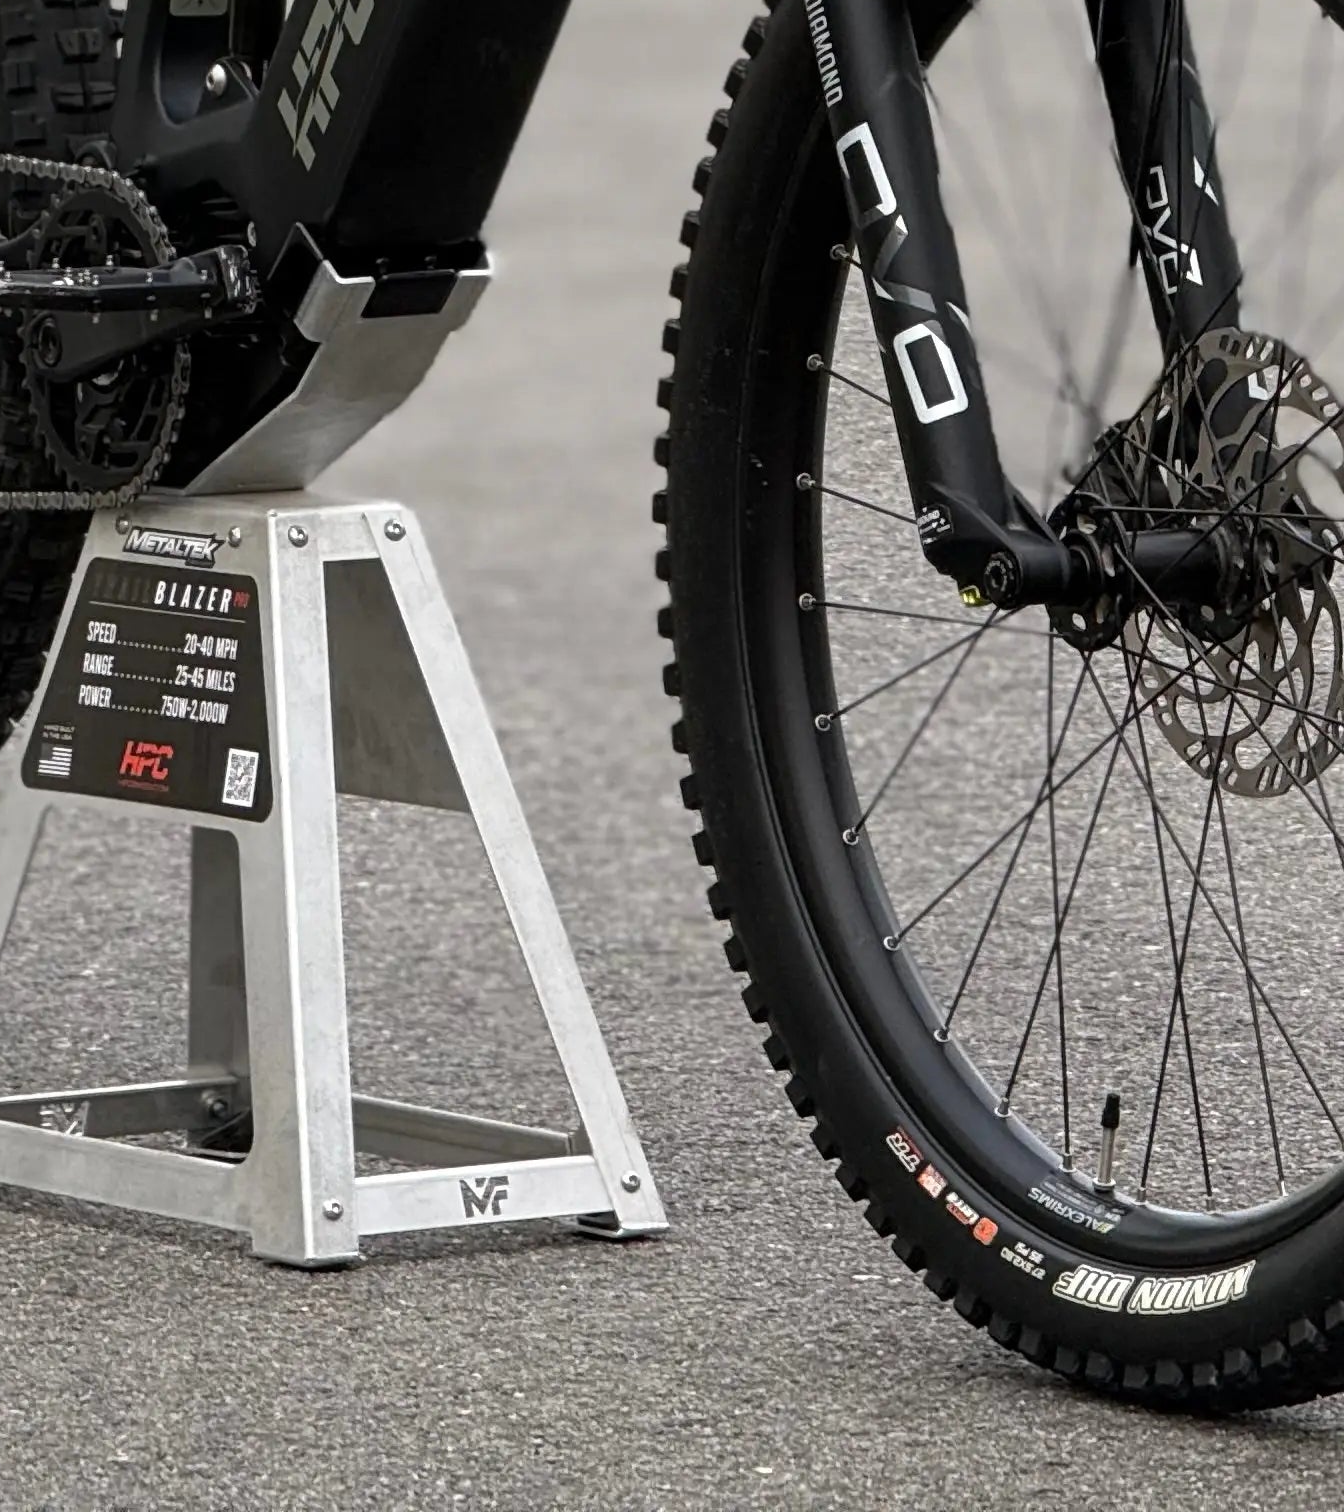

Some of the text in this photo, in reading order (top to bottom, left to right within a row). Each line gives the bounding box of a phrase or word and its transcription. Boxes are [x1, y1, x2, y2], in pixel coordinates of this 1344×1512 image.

[154, 580, 233, 614] BLAZER
[215, 637, 238, 661] MPH
[205, 669, 236, 693] MILES
[1053, 1260, 1256, 1316] DHF MINION
